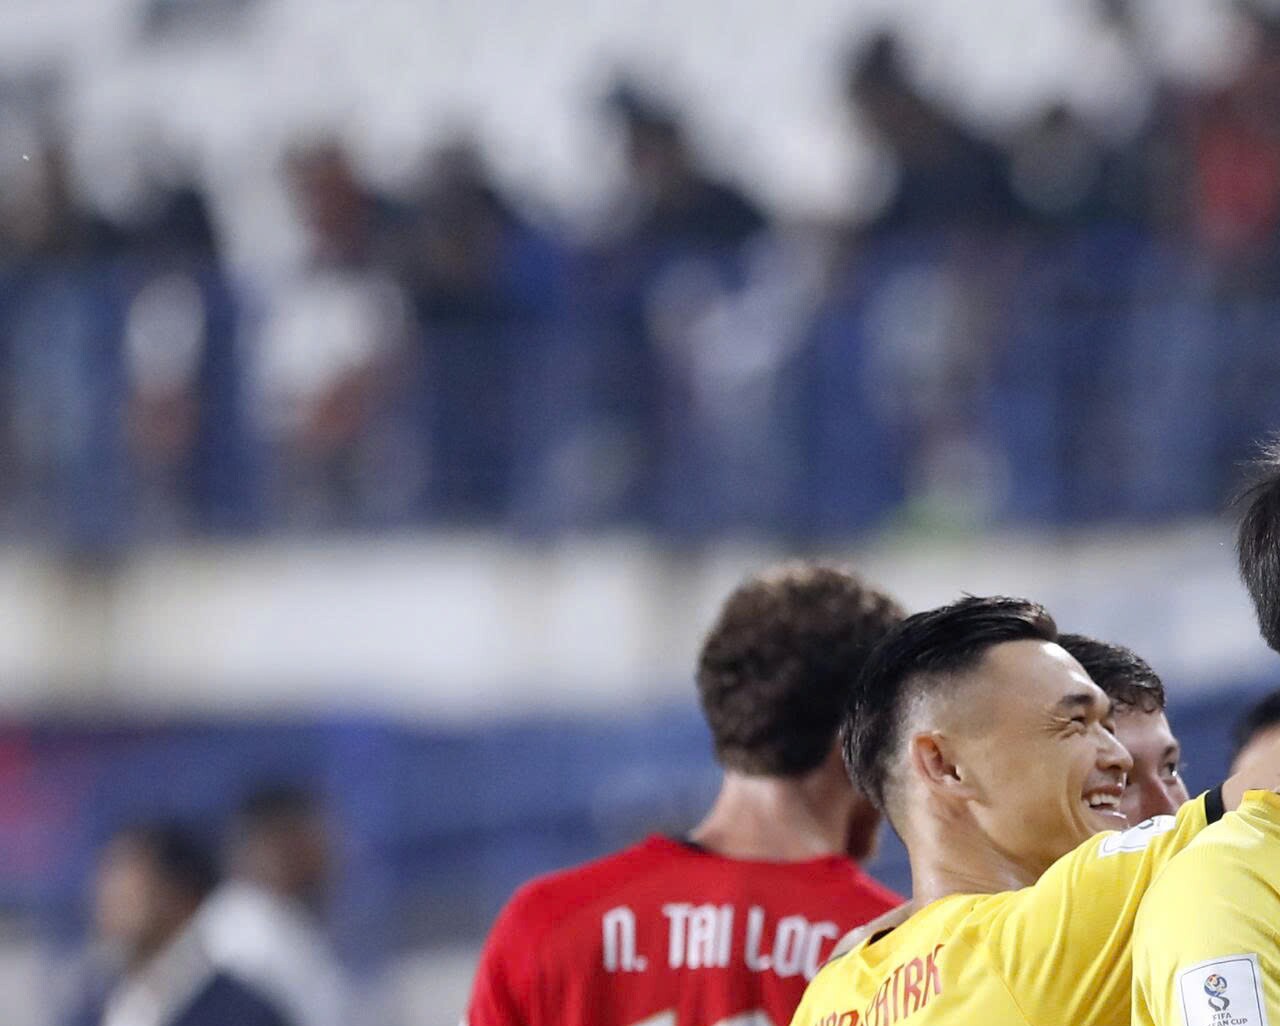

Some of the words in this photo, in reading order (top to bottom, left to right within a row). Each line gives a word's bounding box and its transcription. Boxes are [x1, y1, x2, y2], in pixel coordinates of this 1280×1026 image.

[602, 905, 648, 974] N.
[662, 902, 735, 970] TAI
[744, 905, 839, 982] LOC
[1212, 1012, 1232, 1021] FIFA
[1230, 1017, 1248, 1025] CUP
